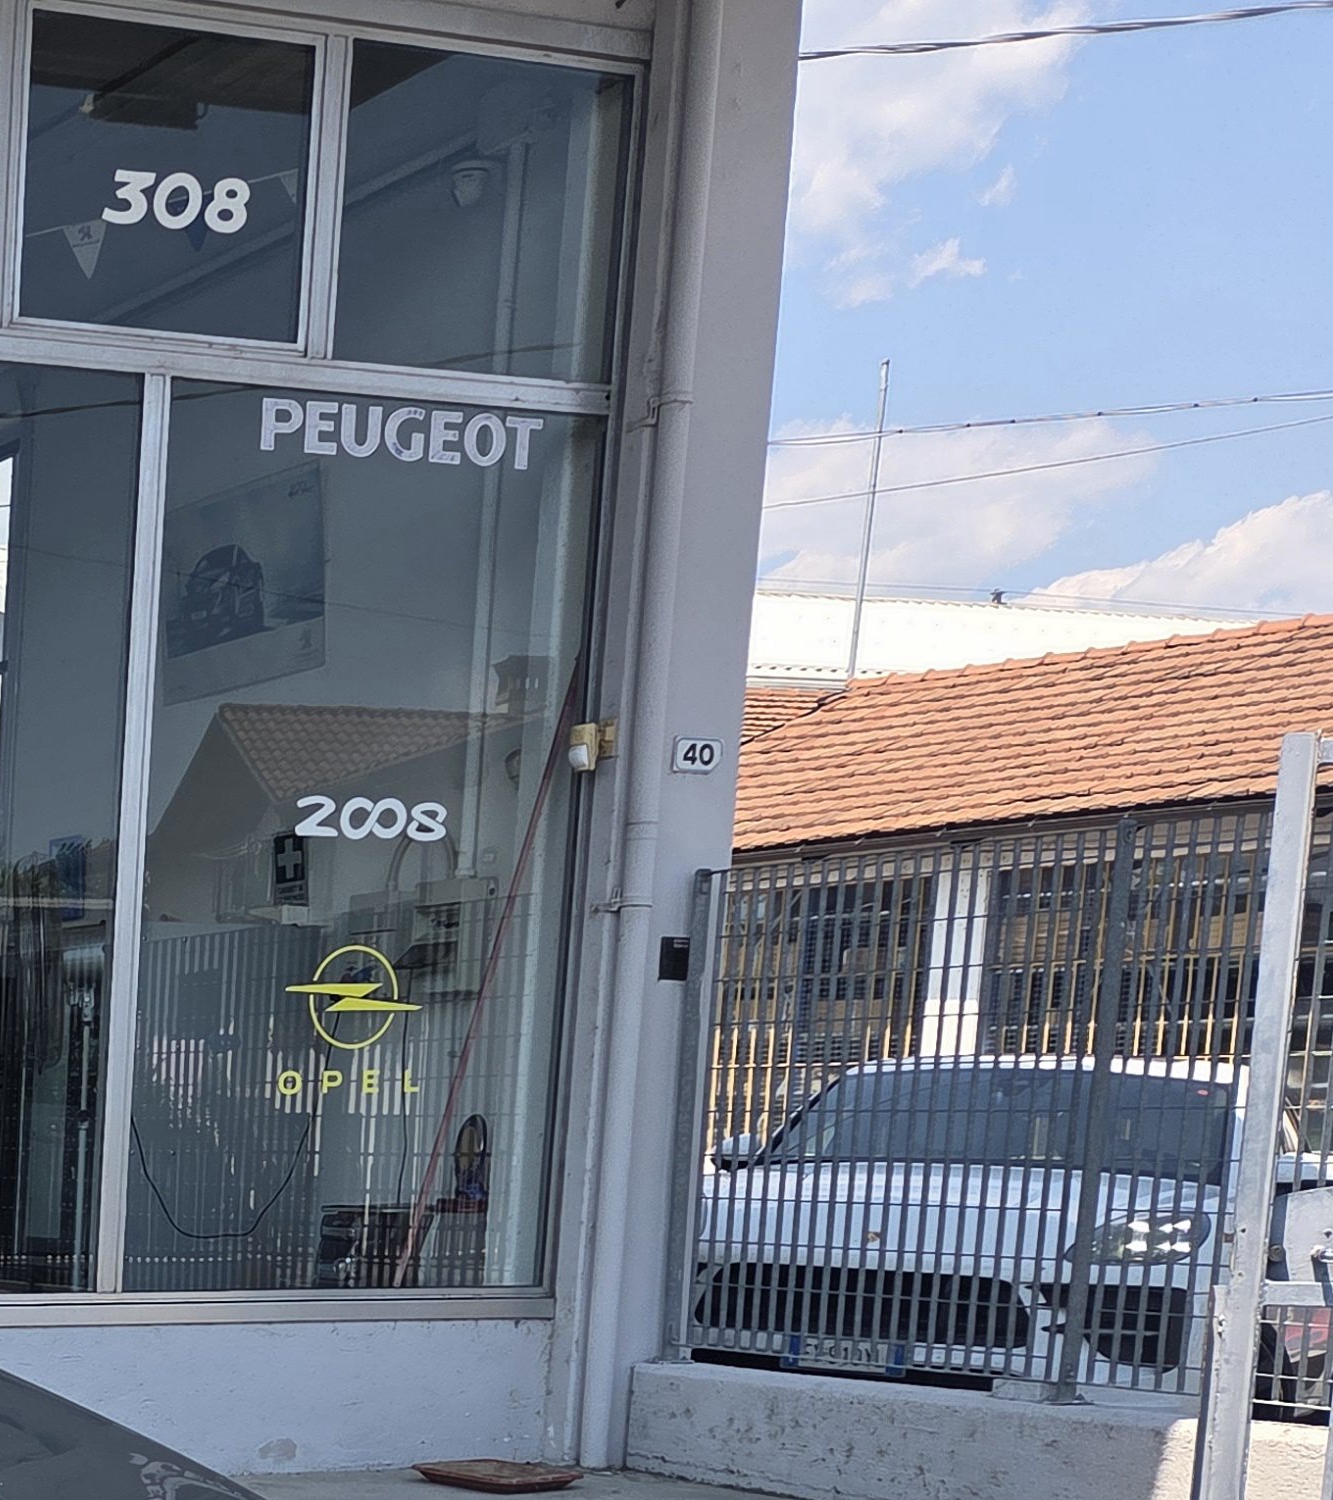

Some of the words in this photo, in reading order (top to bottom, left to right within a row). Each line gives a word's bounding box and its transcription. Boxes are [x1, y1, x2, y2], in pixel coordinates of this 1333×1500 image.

[102, 169, 250, 234] 308
[259, 398, 544, 470] PEUGEOT
[683, 743, 715, 766] 40
[294, 795, 448, 842] 2008
[278, 1069, 420, 1095] OPEL
